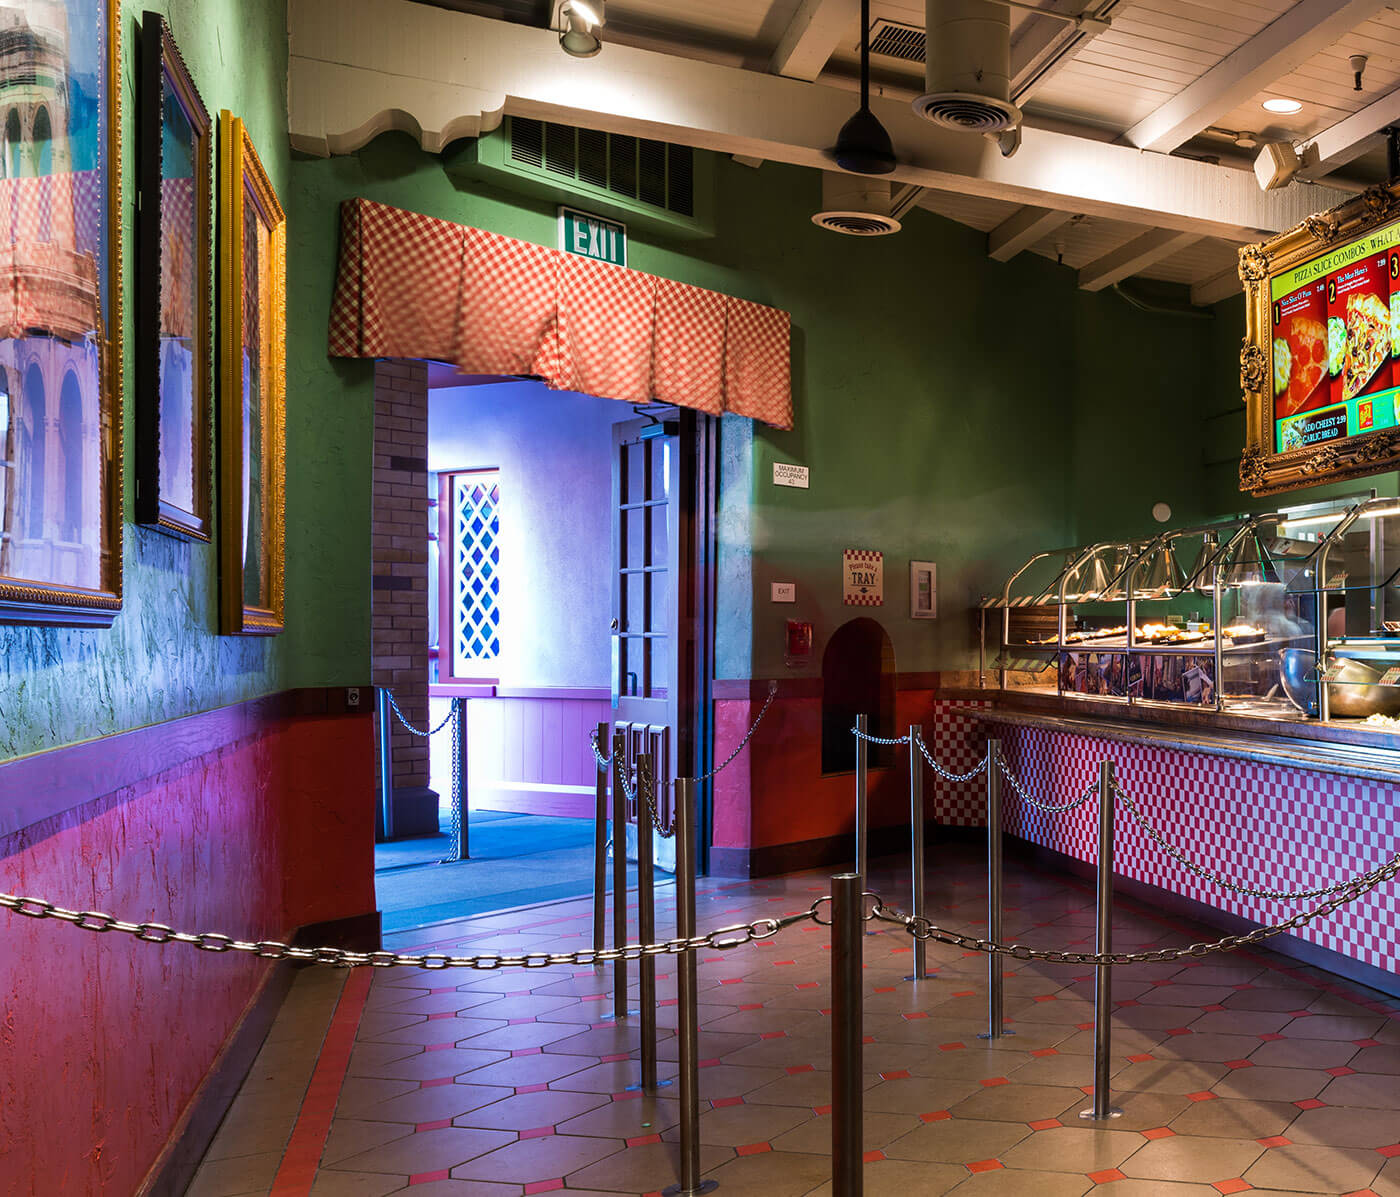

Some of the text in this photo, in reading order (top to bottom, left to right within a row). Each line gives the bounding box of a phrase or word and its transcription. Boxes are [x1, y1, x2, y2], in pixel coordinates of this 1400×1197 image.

[573, 215, 619, 262] EXIT
[1294, 267, 1313, 283] PIZZA
[1313, 257, 1332, 273] SLICE
[1333, 242, 1366, 267] COMBOS
[1370, 231, 1393, 249] WHAT
[1391, 256, 1399, 277] 3
[1330, 283, 1335, 302] 2
[1315, 416, 1336, 430] CHEESY
[774, 470, 808, 481] OCCUPANCY
[851, 571, 876, 585] TRAY
